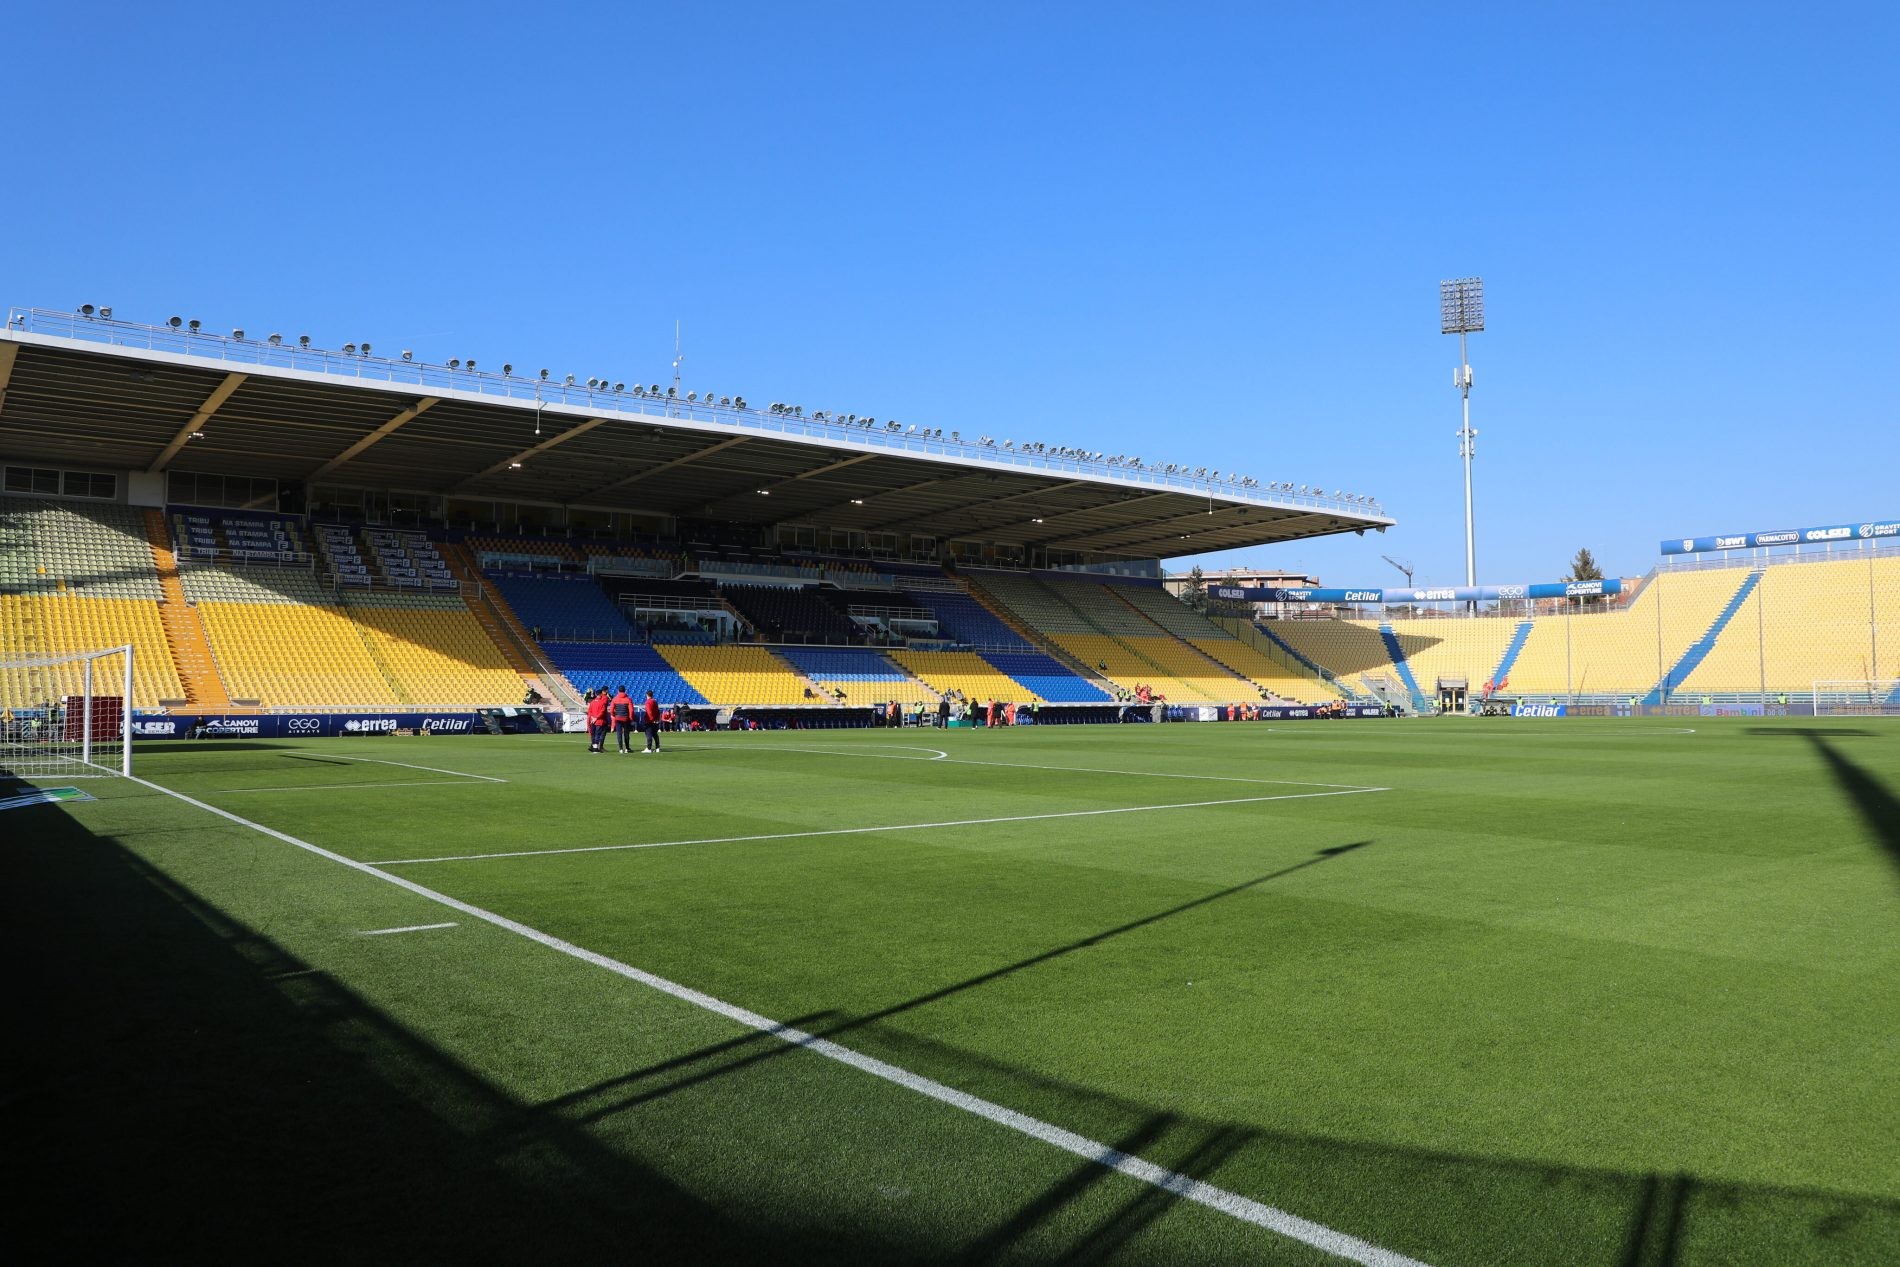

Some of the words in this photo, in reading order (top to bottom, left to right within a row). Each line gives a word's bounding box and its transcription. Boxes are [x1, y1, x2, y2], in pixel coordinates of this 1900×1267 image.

[234, 520, 264, 528] STAMPA
[238, 530, 268, 538] STAMPA
[1757, 533, 1796, 543] PARMACOTTO
[1806, 528, 1851, 540] COLSER
[242, 540, 272, 548] STAMPA
[1725, 536, 1746, 546] BWT
[1218, 588, 1245, 599] COLSER
[1344, 591, 1380, 601] Cetilar
[1515, 705, 1560, 717] Cetilar
[223, 719, 259, 727] CANOVI
[422, 718, 470, 730] Cetilar
[206, 726, 259, 734] COPERTURE
